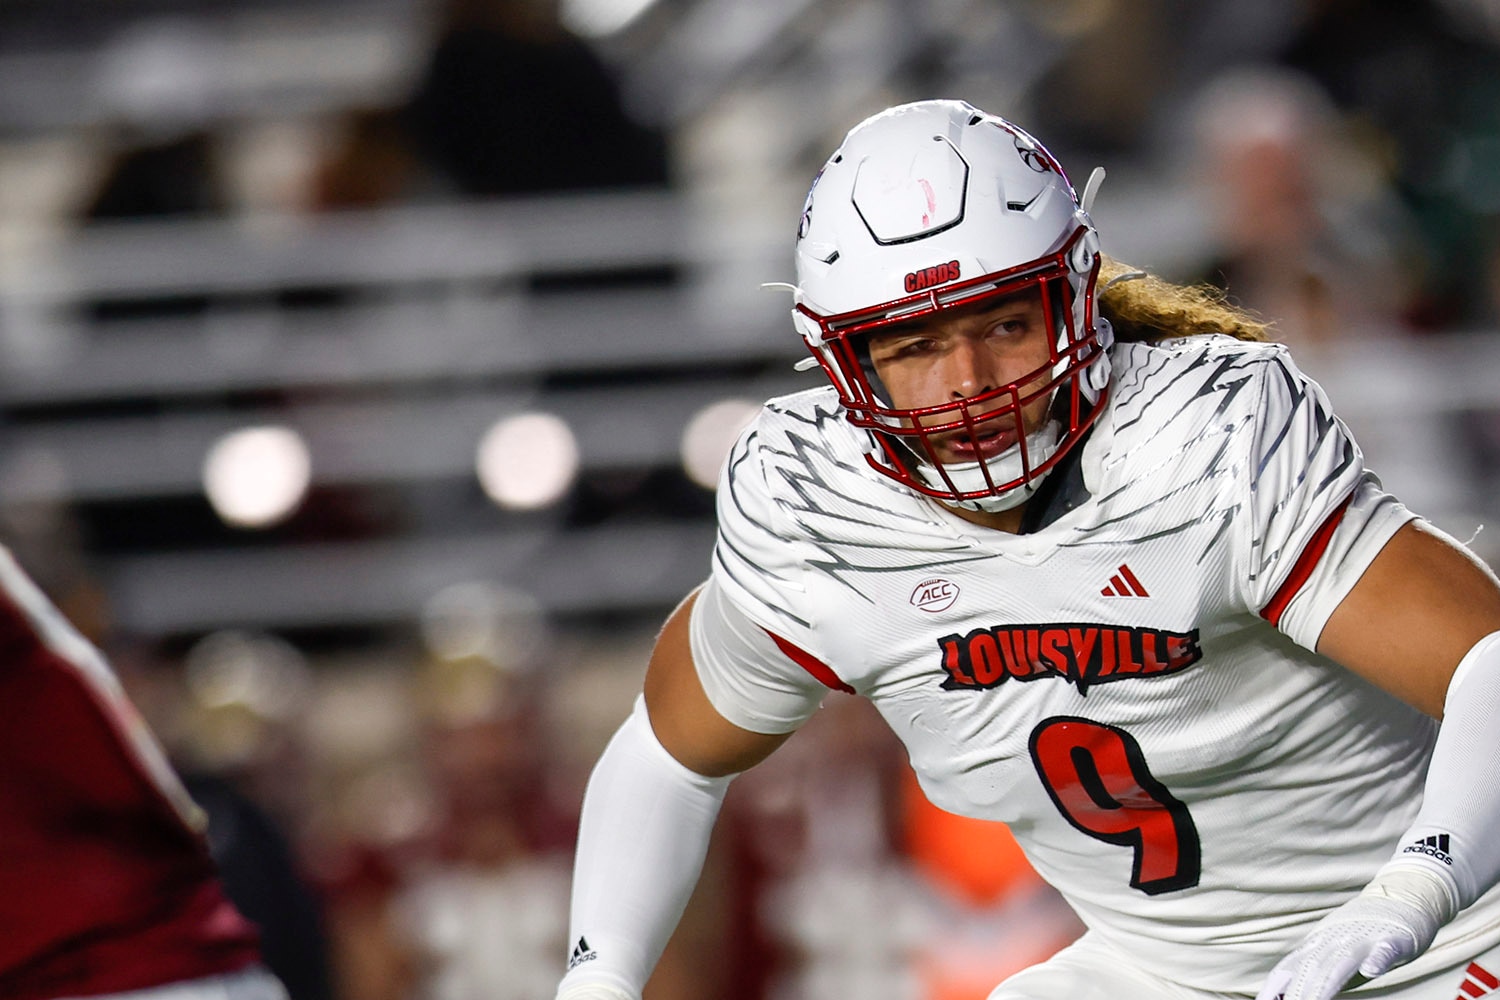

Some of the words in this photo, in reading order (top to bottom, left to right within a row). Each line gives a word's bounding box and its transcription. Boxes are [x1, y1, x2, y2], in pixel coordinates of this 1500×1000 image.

[904, 260, 961, 293] CARDS
[919, 583, 952, 603] ACC
[937, 622, 1203, 697] LOUISVILLE
[1028, 715, 1202, 896] 9
[1403, 843, 1454, 866] adidas
